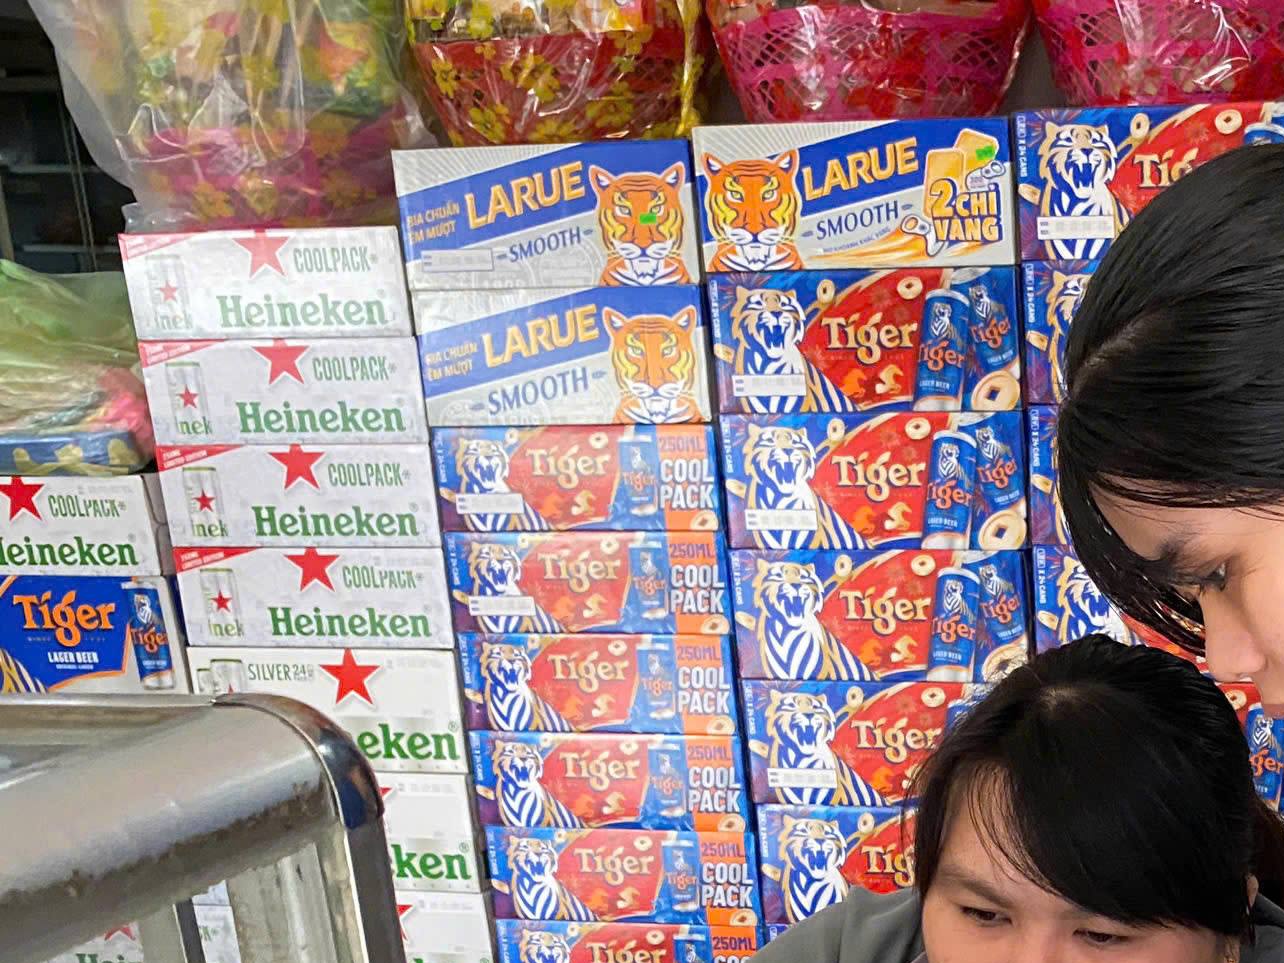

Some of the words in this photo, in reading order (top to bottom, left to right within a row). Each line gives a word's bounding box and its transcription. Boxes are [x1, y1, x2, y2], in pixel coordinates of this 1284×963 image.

[802, 137, 919, 202] LARUE
[465, 161, 586, 231] LARUE
[930, 178, 953, 217] 2
[816, 200, 899, 241] SMOOTH
[293, 246, 371, 274] COOLPACK
[509, 226, 582, 262] SMOOTH
[216, 293, 389, 329] Heineken
[482, 303, 599, 368] LARUE
[822, 312, 919, 366] Tiger
[312, 357, 389, 382] COOLPACK
[488, 366, 589, 417] SMOOTH
[236, 401, 406, 434] Heineken
[328, 463, 403, 487] COOLPACK
[527, 444, 610, 490] Tiger
[660, 458, 715, 484] COOL
[831, 451, 926, 502] Tiger
[48, 495, 121, 518] COOLPACK
[659, 484, 714, 509] PACK
[252, 506, 419, 537] Heineken
[0, 536, 140, 566] eineken
[342, 565, 418, 589] COOLPACK
[538, 548, 621, 593] Tiger
[670, 564, 725, 588] COOL
[670, 589, 724, 613] PACK
[839, 587, 932, 635] Tiger
[13, 590, 116, 648] Tiger
[268, 607, 432, 638] Heineken
[248, 664, 291, 681] SILVER
[548, 647, 629, 693] Tiger
[677, 666, 730, 690] COOL
[677, 690, 730, 714] PACK
[357, 723, 461, 761] eken
[851, 716, 943, 763] Tiger
[559, 750, 640, 791] Tiger
[688, 766, 741, 789] COOL
[1249, 747, 1284, 776] ger
[687, 789, 741, 812] PACK
[574, 845, 655, 886] Tiger
[702, 862, 754, 885] COOL
[861, 845, 915, 887] Tig
[701, 885, 753, 908] PACK
[712, 936, 756, 951] 250ML
